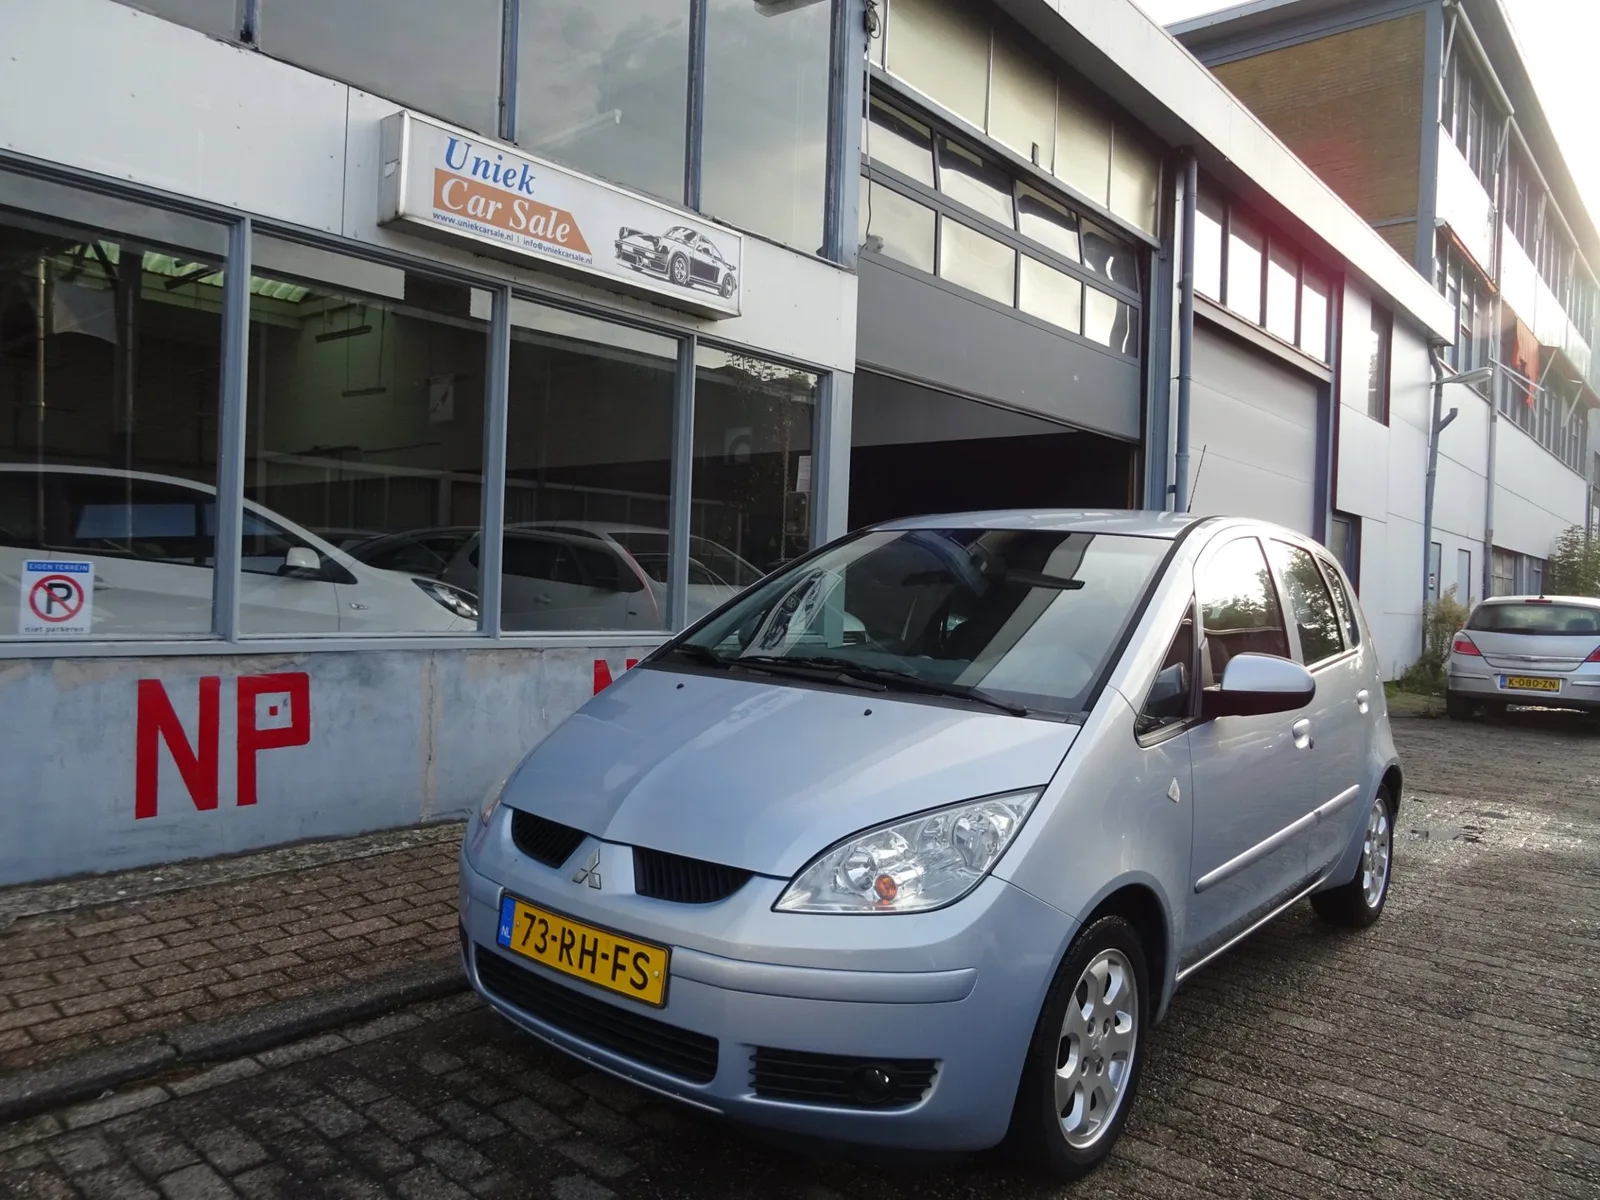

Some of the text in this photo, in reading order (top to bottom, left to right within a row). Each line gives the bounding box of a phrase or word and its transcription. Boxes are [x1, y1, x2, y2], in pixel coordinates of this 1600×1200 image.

[445, 136, 536, 195] Uniek
[432, 211, 514, 242] www.uniekcarsale.nl
[523, 236, 593, 265] info@uniekcarsale.nl
[441, 178, 571, 243] Car Sale
[135, 671, 310, 820] NP
[501, 911, 650, 991] NL 73-RH-FS
